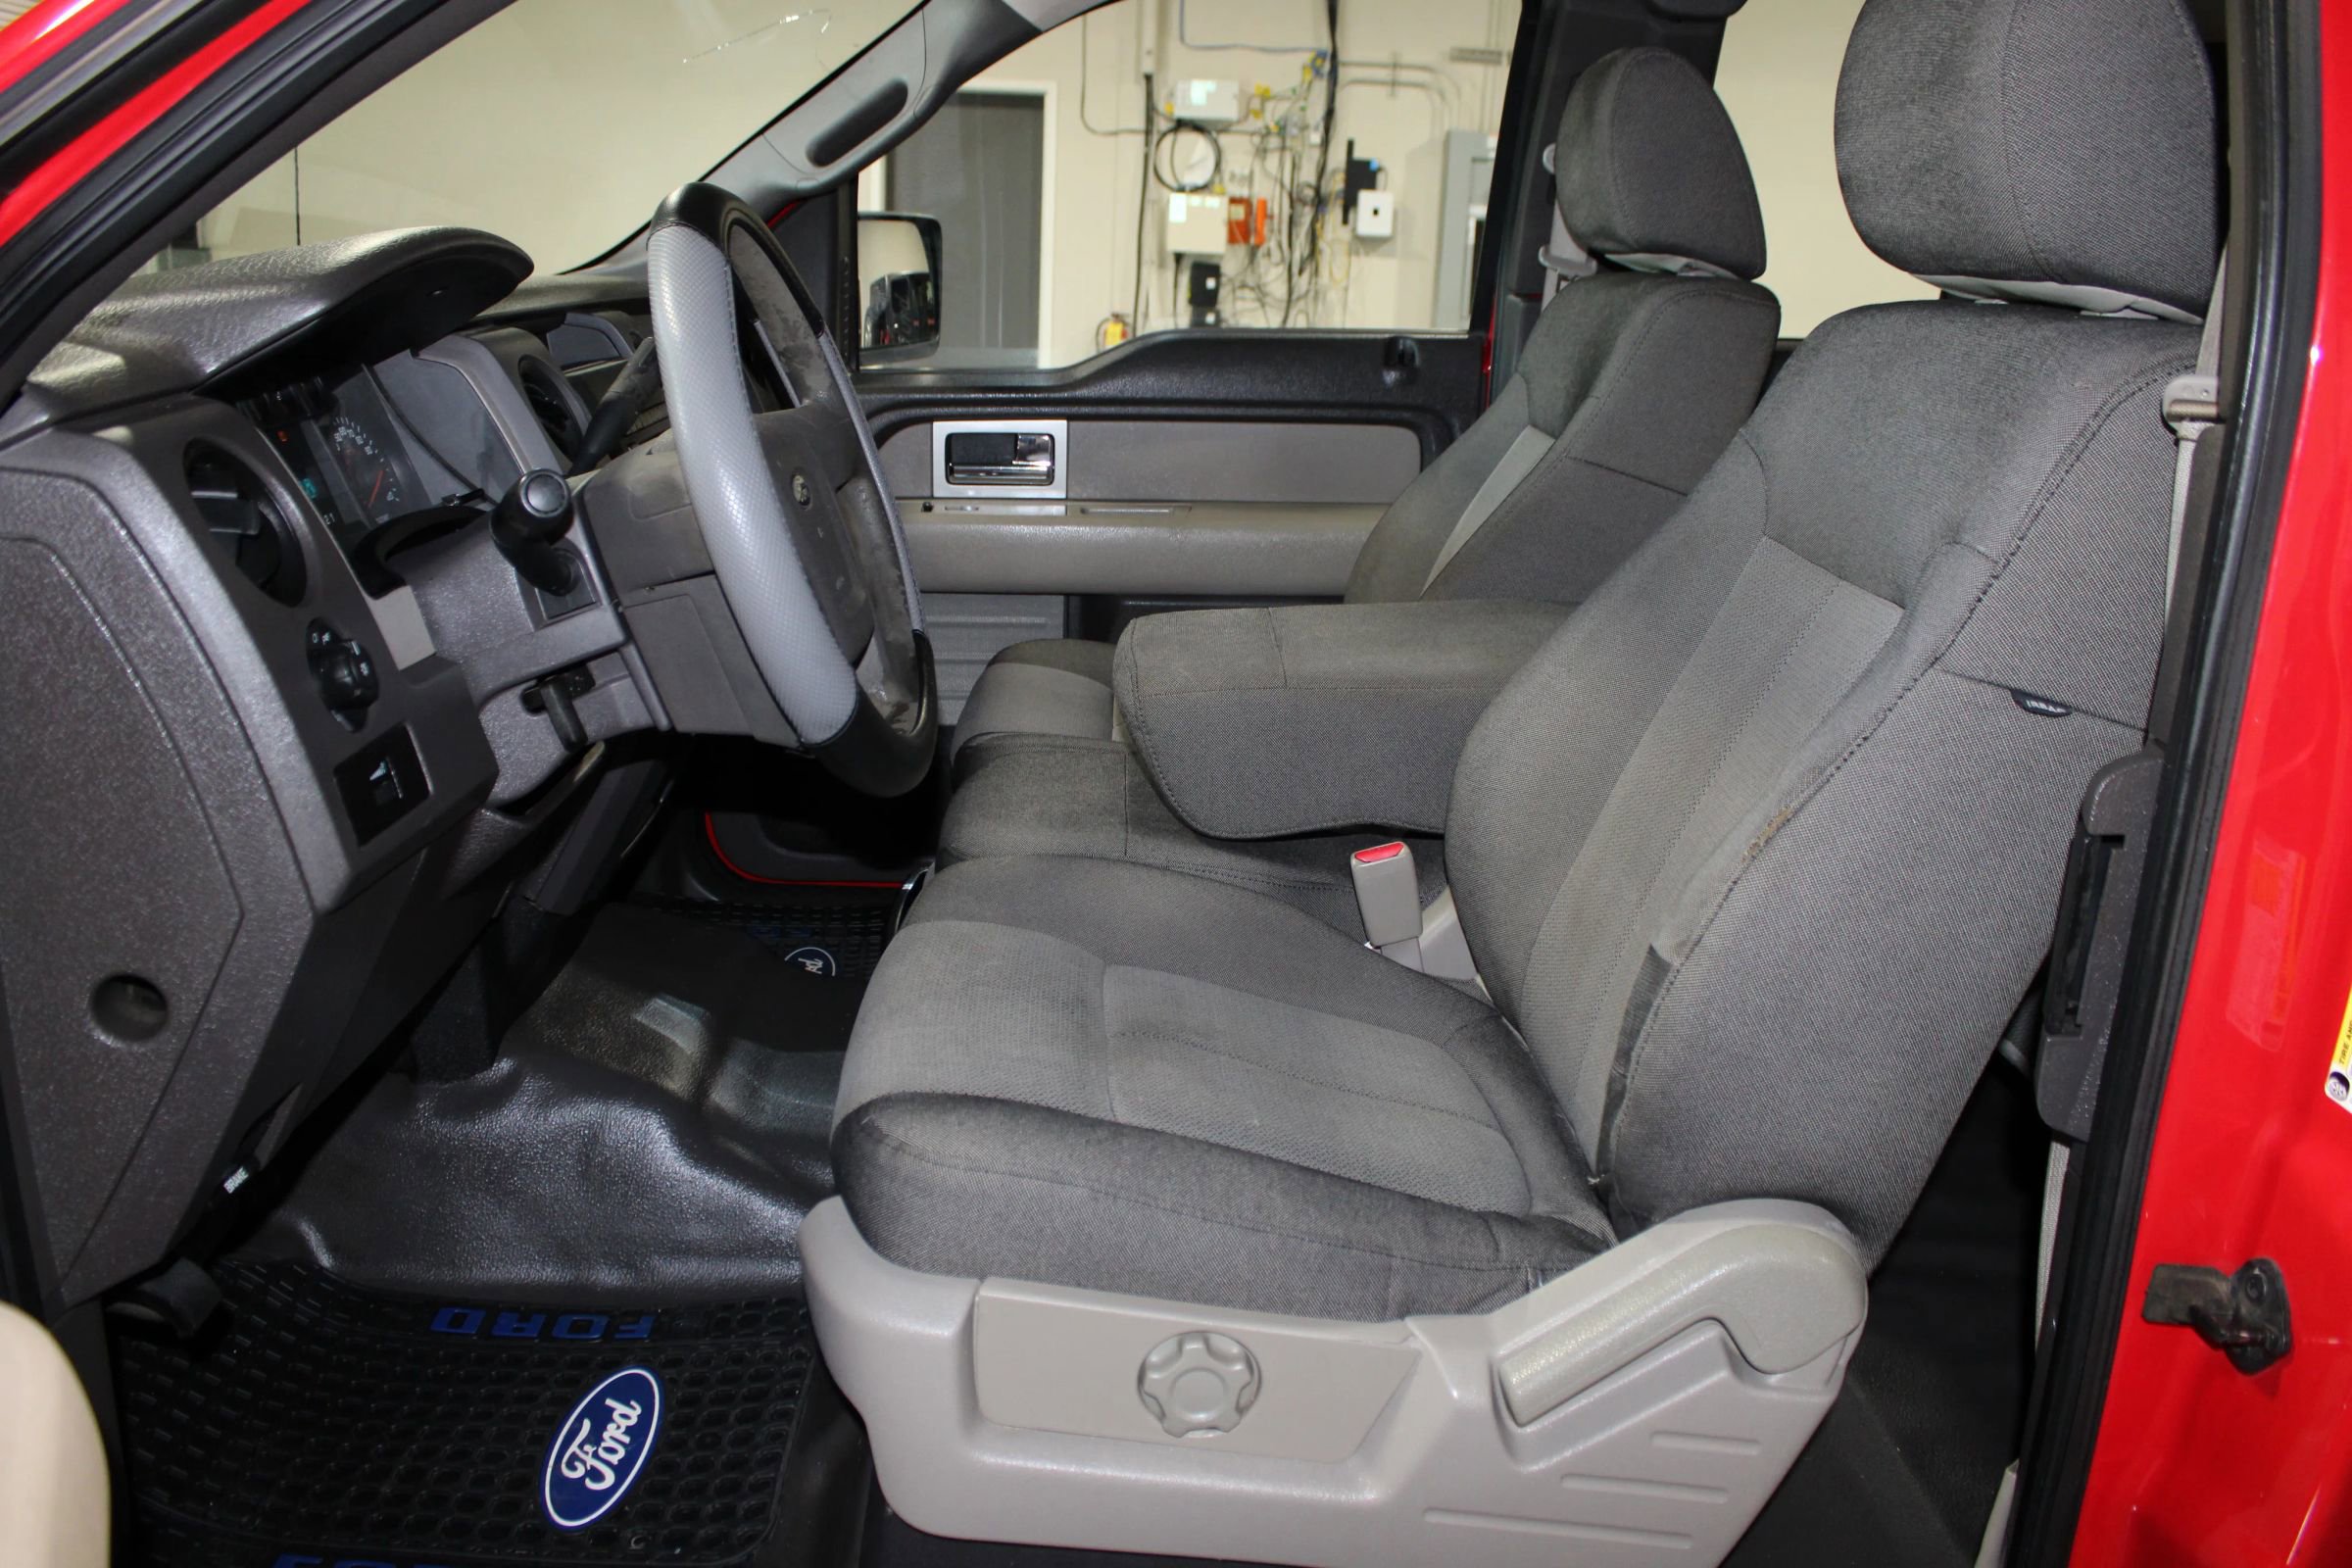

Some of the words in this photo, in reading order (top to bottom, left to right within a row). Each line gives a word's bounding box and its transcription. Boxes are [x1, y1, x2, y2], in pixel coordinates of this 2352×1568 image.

[2339, 1042, 2349, 1065] TIRE
[223, 1166, 249, 1194] BRAKE
[430, 1306, 656, 1339] FORD
[561, 1397, 642, 1491] Ford
